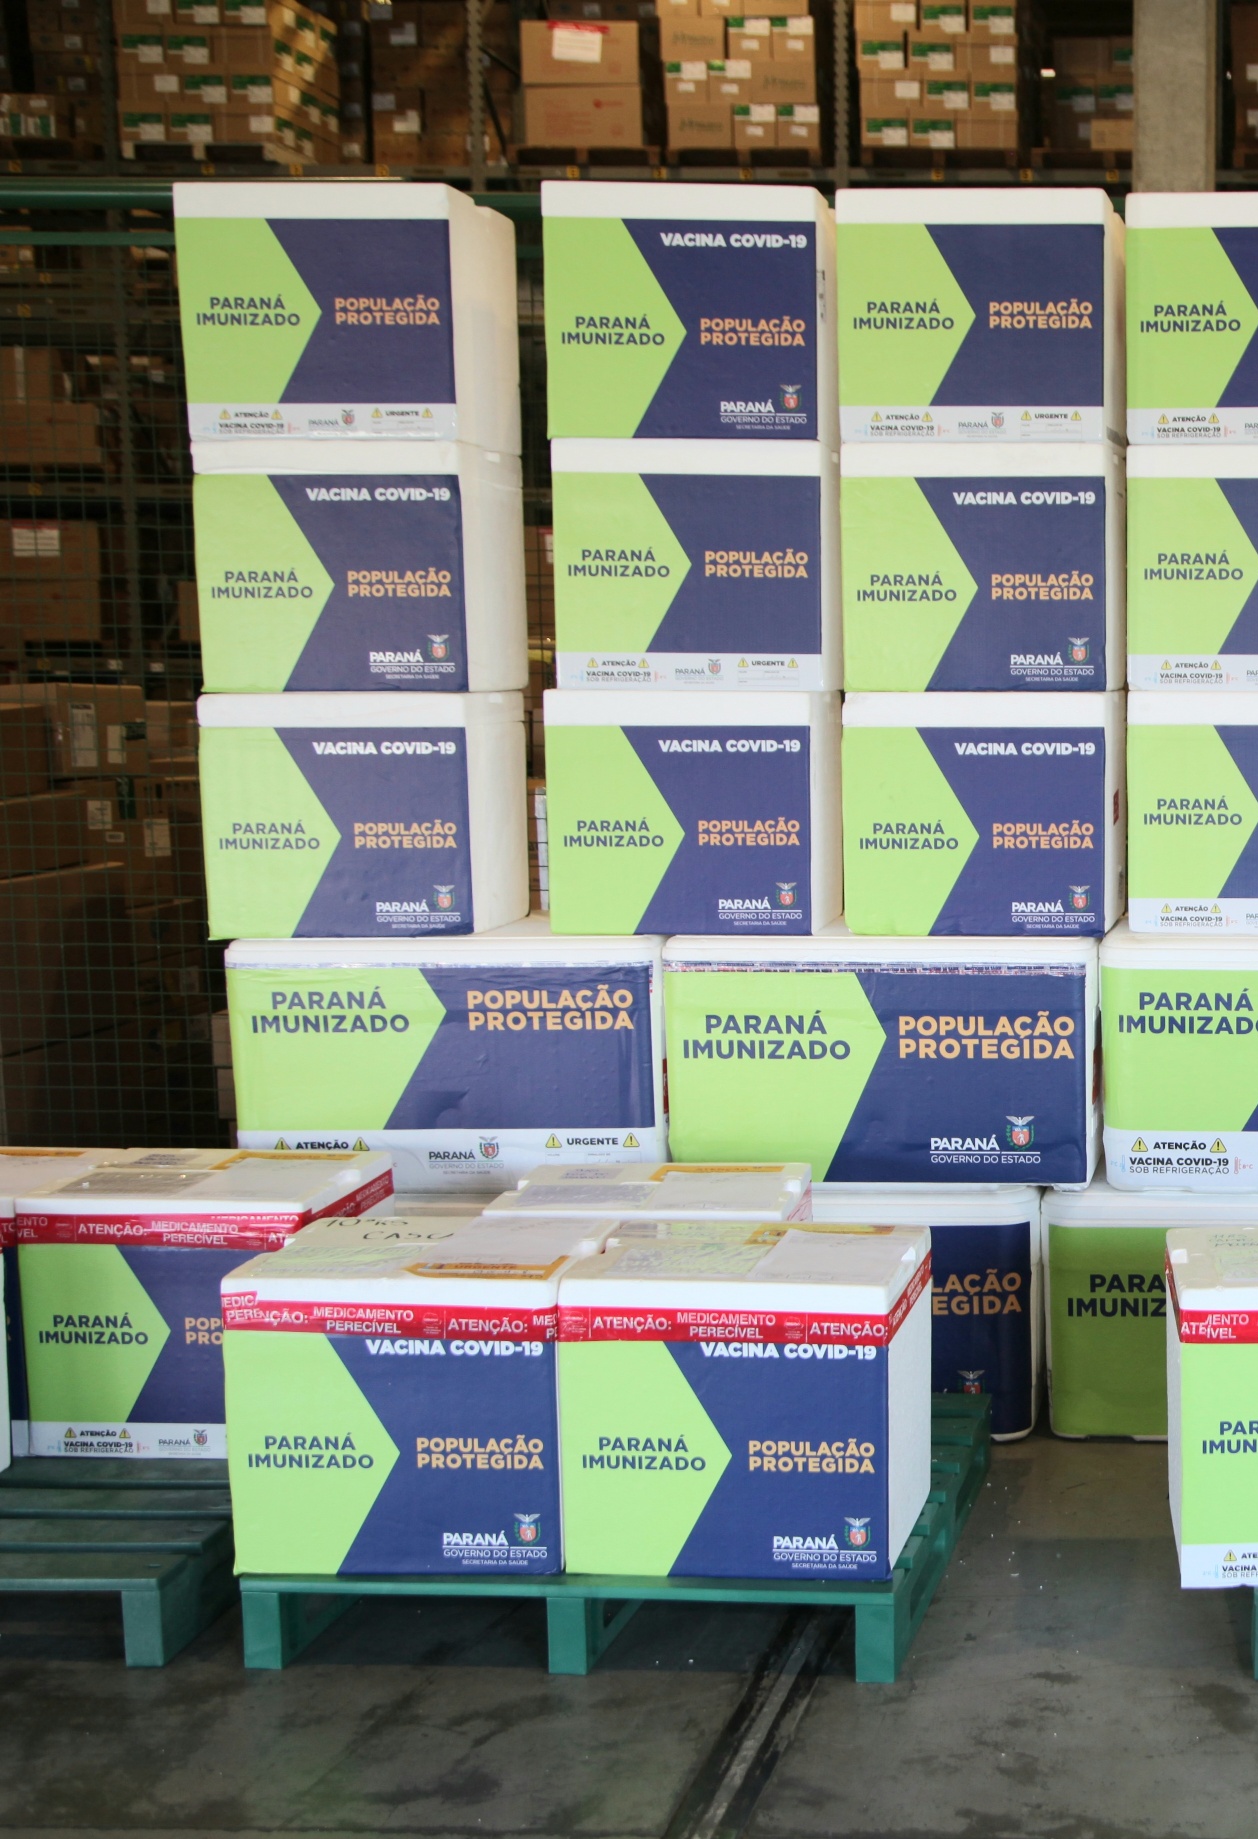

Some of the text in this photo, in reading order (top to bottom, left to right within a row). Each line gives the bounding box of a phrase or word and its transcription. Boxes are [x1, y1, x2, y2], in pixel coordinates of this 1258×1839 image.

[661, 233, 807, 248] VACINA COVID-19
[210, 295, 285, 309] PARANÁ
[335, 295, 439, 314] POPULAÇÃO
[1154, 301, 1226, 316] PARANÁ
[197, 313, 300, 326] IMUNIZADO
[336, 309, 439, 324] PROTEGIDA
[576, 316, 650, 329] PARANÁ
[700, 316, 806, 335] POPULAÇÃO
[1141, 320, 1240, 332] IMUNIZADO
[562, 332, 664, 345] IMUNIZADO
[701, 330, 804, 345] PROTEGIDA
[306, 488, 450, 500] VACINA COVID-19
[582, 549, 655, 561] PARANÁ
[347, 568, 451, 587] POPULAÇÃO
[568, 565, 669, 577] IMUNIZADO
[871, 572, 942, 586] PARANÁ
[348, 582, 450, 596] PROTEGIDA
[857, 590, 956, 601] IMUNIZADO
[1011, 652, 1063, 666] PARANÁ
[1011, 667, 1094, 677] GOVERNO DO ESTADO
[659, 740, 800, 752] VACINA COVID-19
[1158, 796, 1228, 810] PARANÁ
[1144, 814, 1242, 825] IMUNIZADO
[233, 822, 305, 834] PARANÁ
[220, 838, 319, 849] IMUNIZADO
[272, 986, 386, 1009] PARANÁ
[467, 985, 633, 1013] POPULAÇÃO
[1140, 988, 1253, 1011] PARANÁ
[252, 1015, 409, 1033] IMUNIZADO
[469, 1007, 633, 1030] PROTEGIDA
[706, 1010, 827, 1034] PARANÁ
[899, 1011, 1074, 1041] POPULAÇÃO
[684, 1040, 850, 1059] IMUNIZADO
[900, 1034, 1074, 1058] PROTEGIDA
[567, 1137, 618, 1145] URGENTE
[931, 1134, 999, 1151] PARANÁ
[1154, 1140, 1206, 1152] ATENÇÃO
[931, 1153, 1040, 1163] GOVERNO DO ESTADO
[1130, 1157, 1228, 1168] VACINA COVID-19
[1130, 1164, 1229, 1175] SOB REFRIGERAÇÃO
[79, 1222, 148, 1237] ATENÇÃO:
[150, 1220, 239, 1236] MEDICAMENTO
[163, 1231, 229, 1244] PERECÍVEL
[53, 1313, 132, 1328] PARANÁ
[312, 1307, 413, 1323] MEDICAMENTO
[677, 1311, 775, 1328] MEDICAMENTO
[327, 1318, 401, 1335] PERECÍVEL
[448, 1317, 527, 1334] ATENÇÃO:
[593, 1315, 671, 1332] ATENÇÃO:
[690, 1322, 763, 1338] PERECÍVEL
[39, 1331, 147, 1344] IMUNIZADO
[366, 1340, 543, 1356] VACINA COVID-19
[700, 1342, 876, 1360] VACINA COVID-19
[265, 1433, 355, 1450] PARANÁ
[416, 1435, 543, 1457] POPULAÇÃO
[599, 1435, 688, 1456] PARANÁ
[749, 1439, 875, 1461] POPULAÇÃO
[249, 1454, 373, 1468] IMUNIZADO
[418, 1450, 542, 1468] PROTEGIDA
[583, 1455, 705, 1471] IMUNIZADO
[749, 1454, 874, 1473] PROTEGIDA
